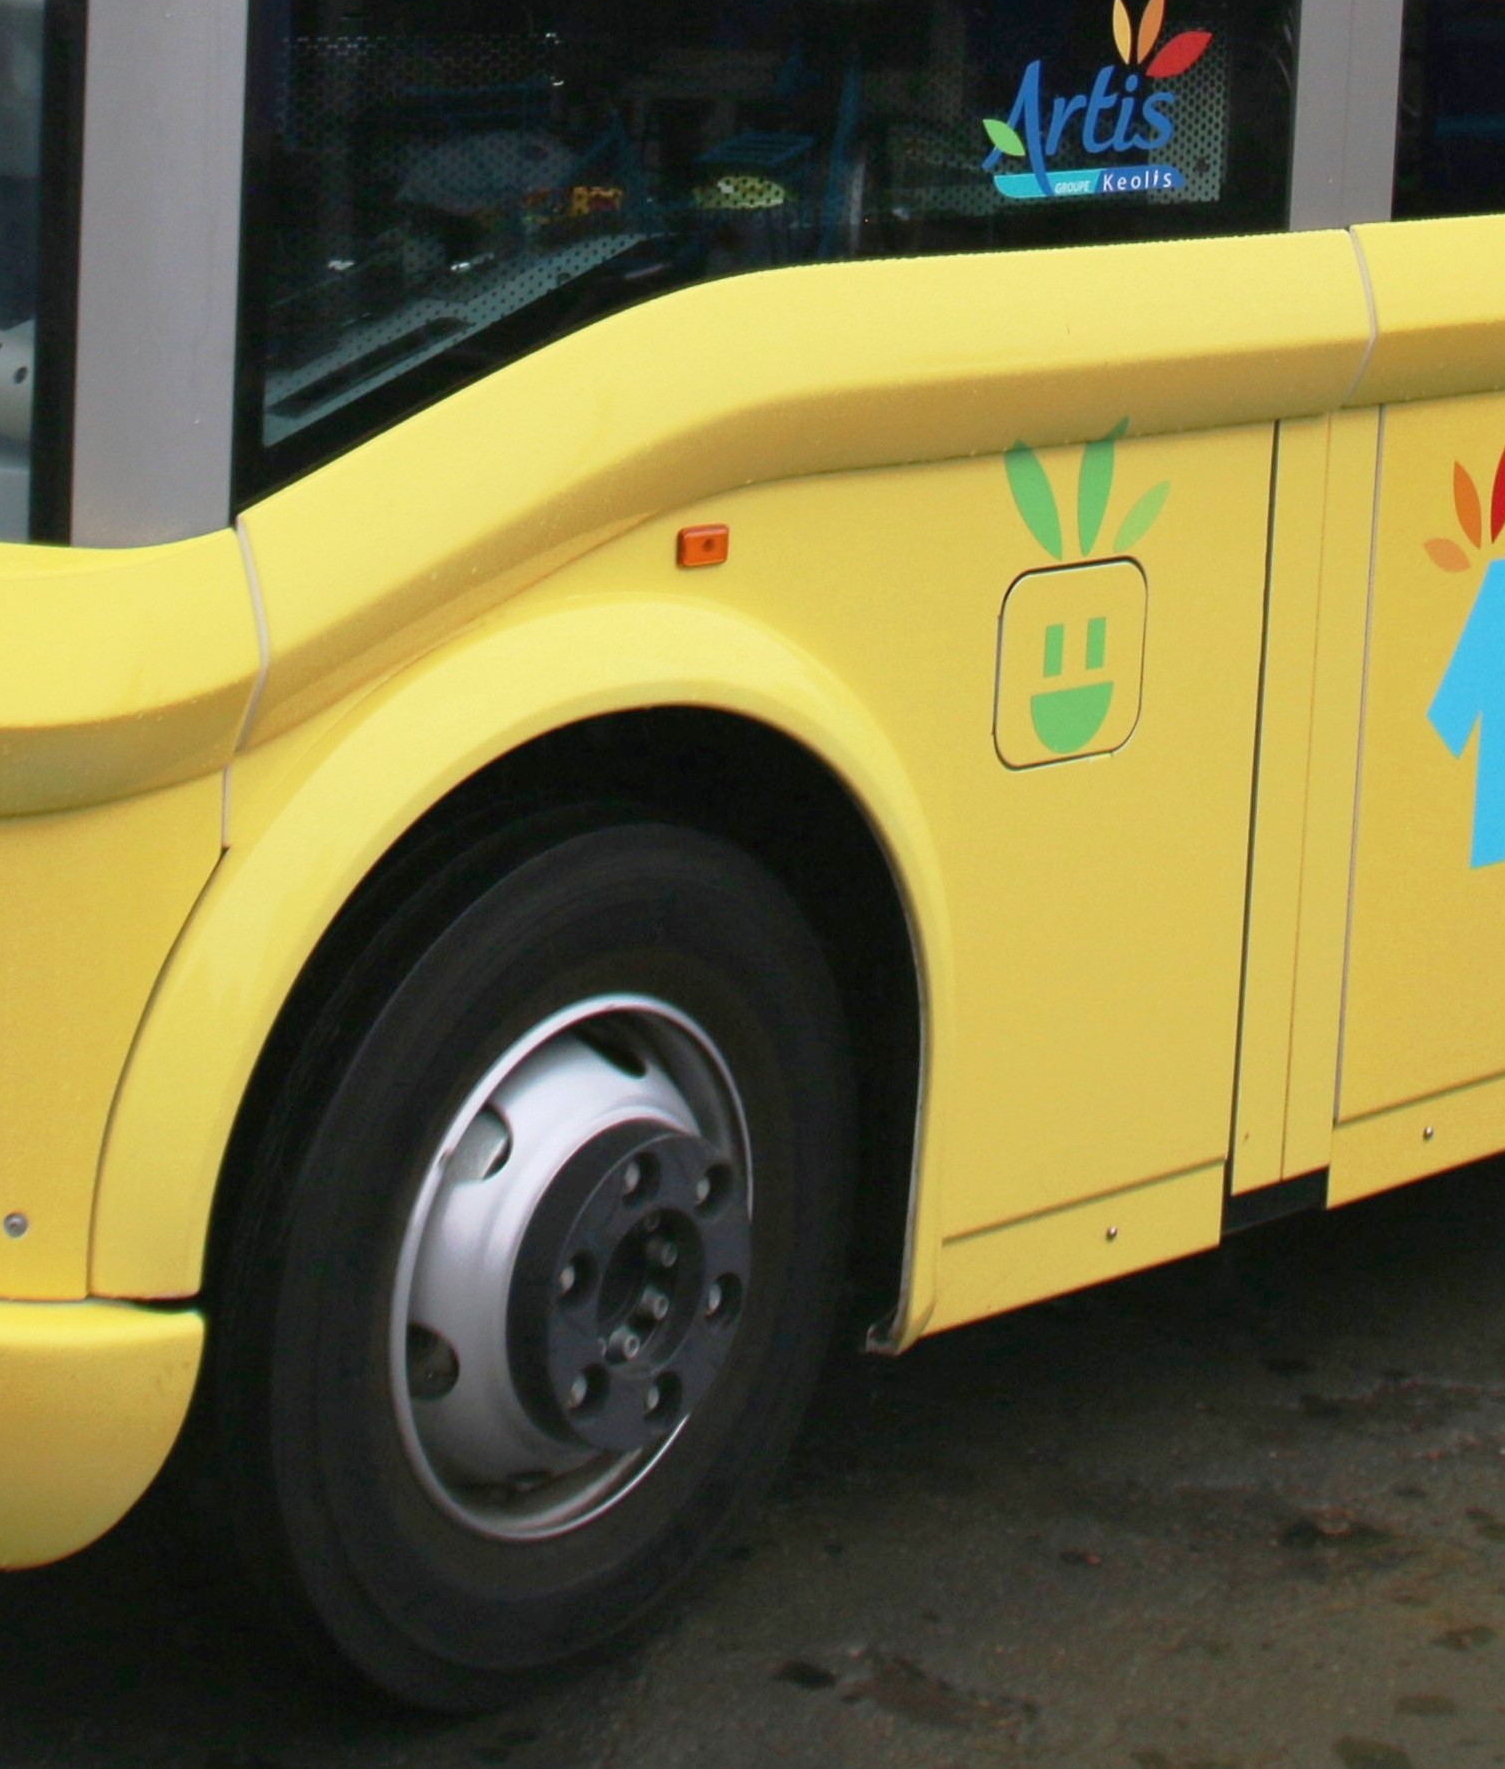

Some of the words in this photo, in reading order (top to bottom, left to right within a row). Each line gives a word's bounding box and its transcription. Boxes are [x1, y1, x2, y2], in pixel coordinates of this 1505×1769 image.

[981, 59, 1176, 196] Artis
[1054, 180, 1091, 194] GROUPE
[1102, 169, 1173, 192] Keolis
